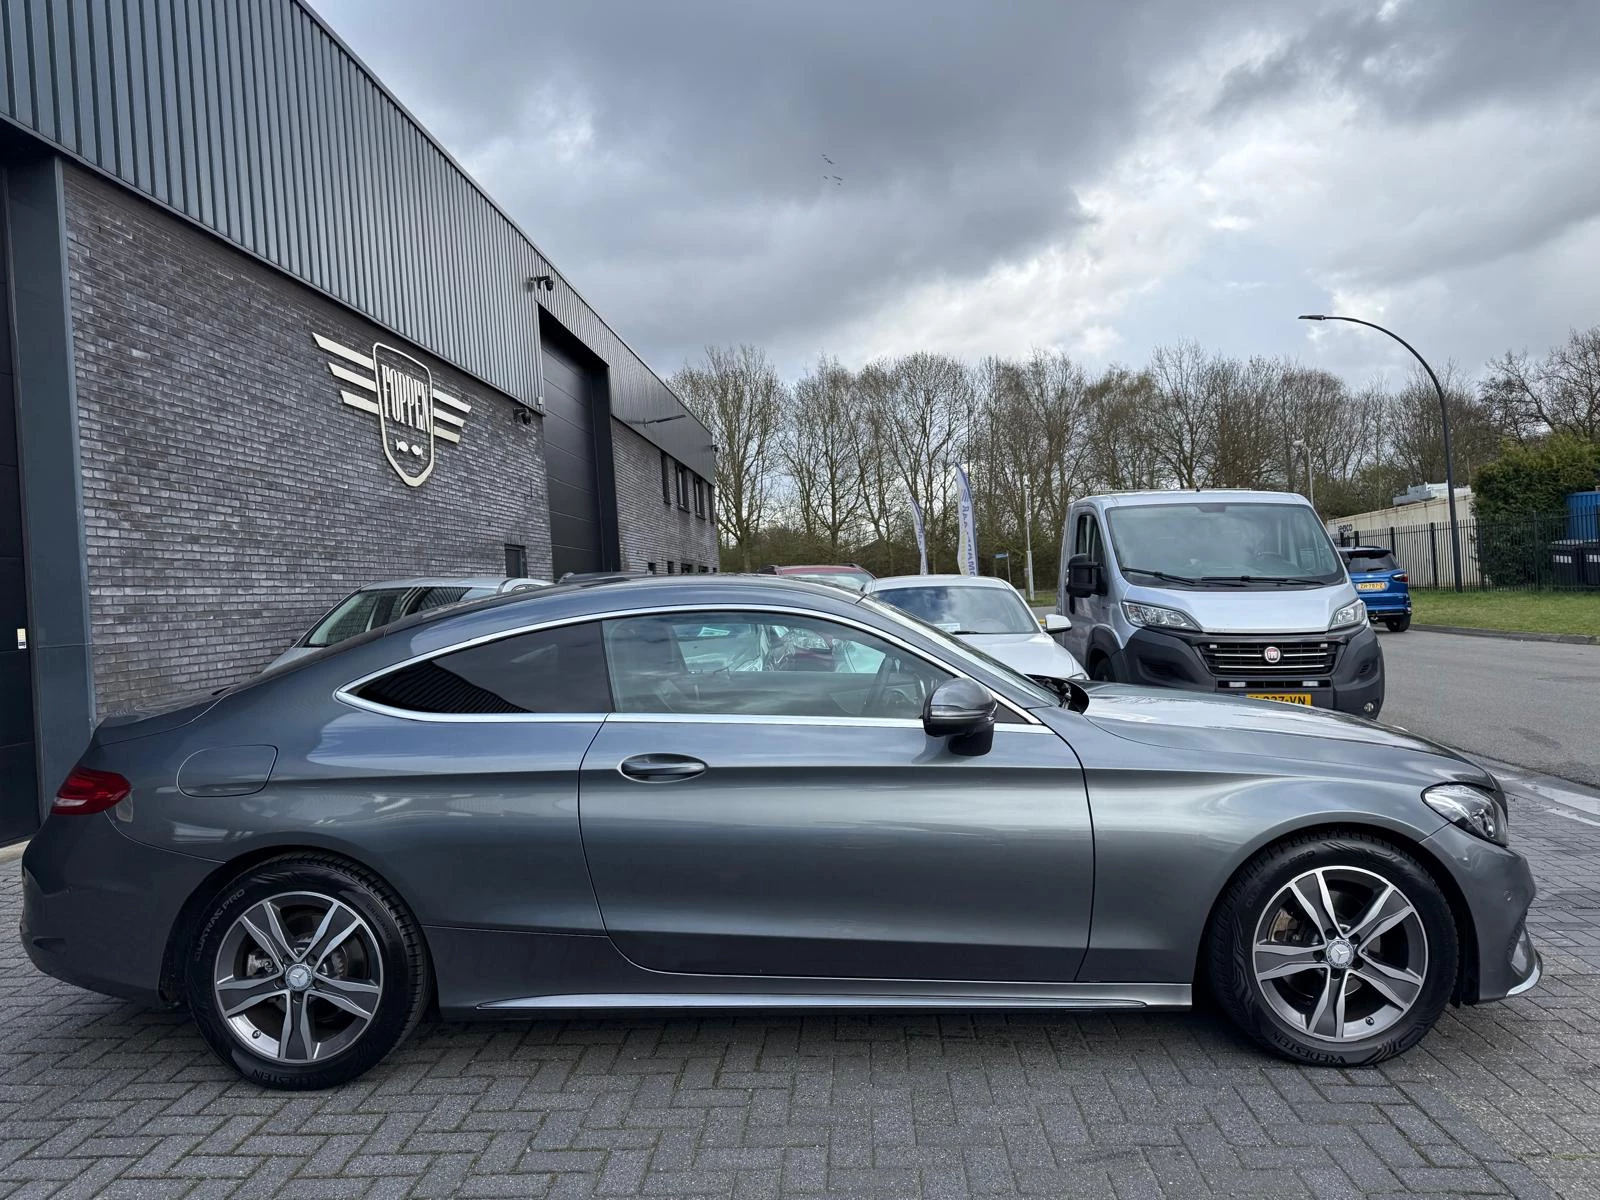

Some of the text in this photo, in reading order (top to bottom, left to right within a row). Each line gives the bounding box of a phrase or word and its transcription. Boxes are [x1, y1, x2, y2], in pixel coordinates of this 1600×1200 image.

[381, 364, 431, 433] FOPPEN
[221, 888, 246, 910] PRO
[1272, 1031, 1347, 1064] VREDESTEIN
